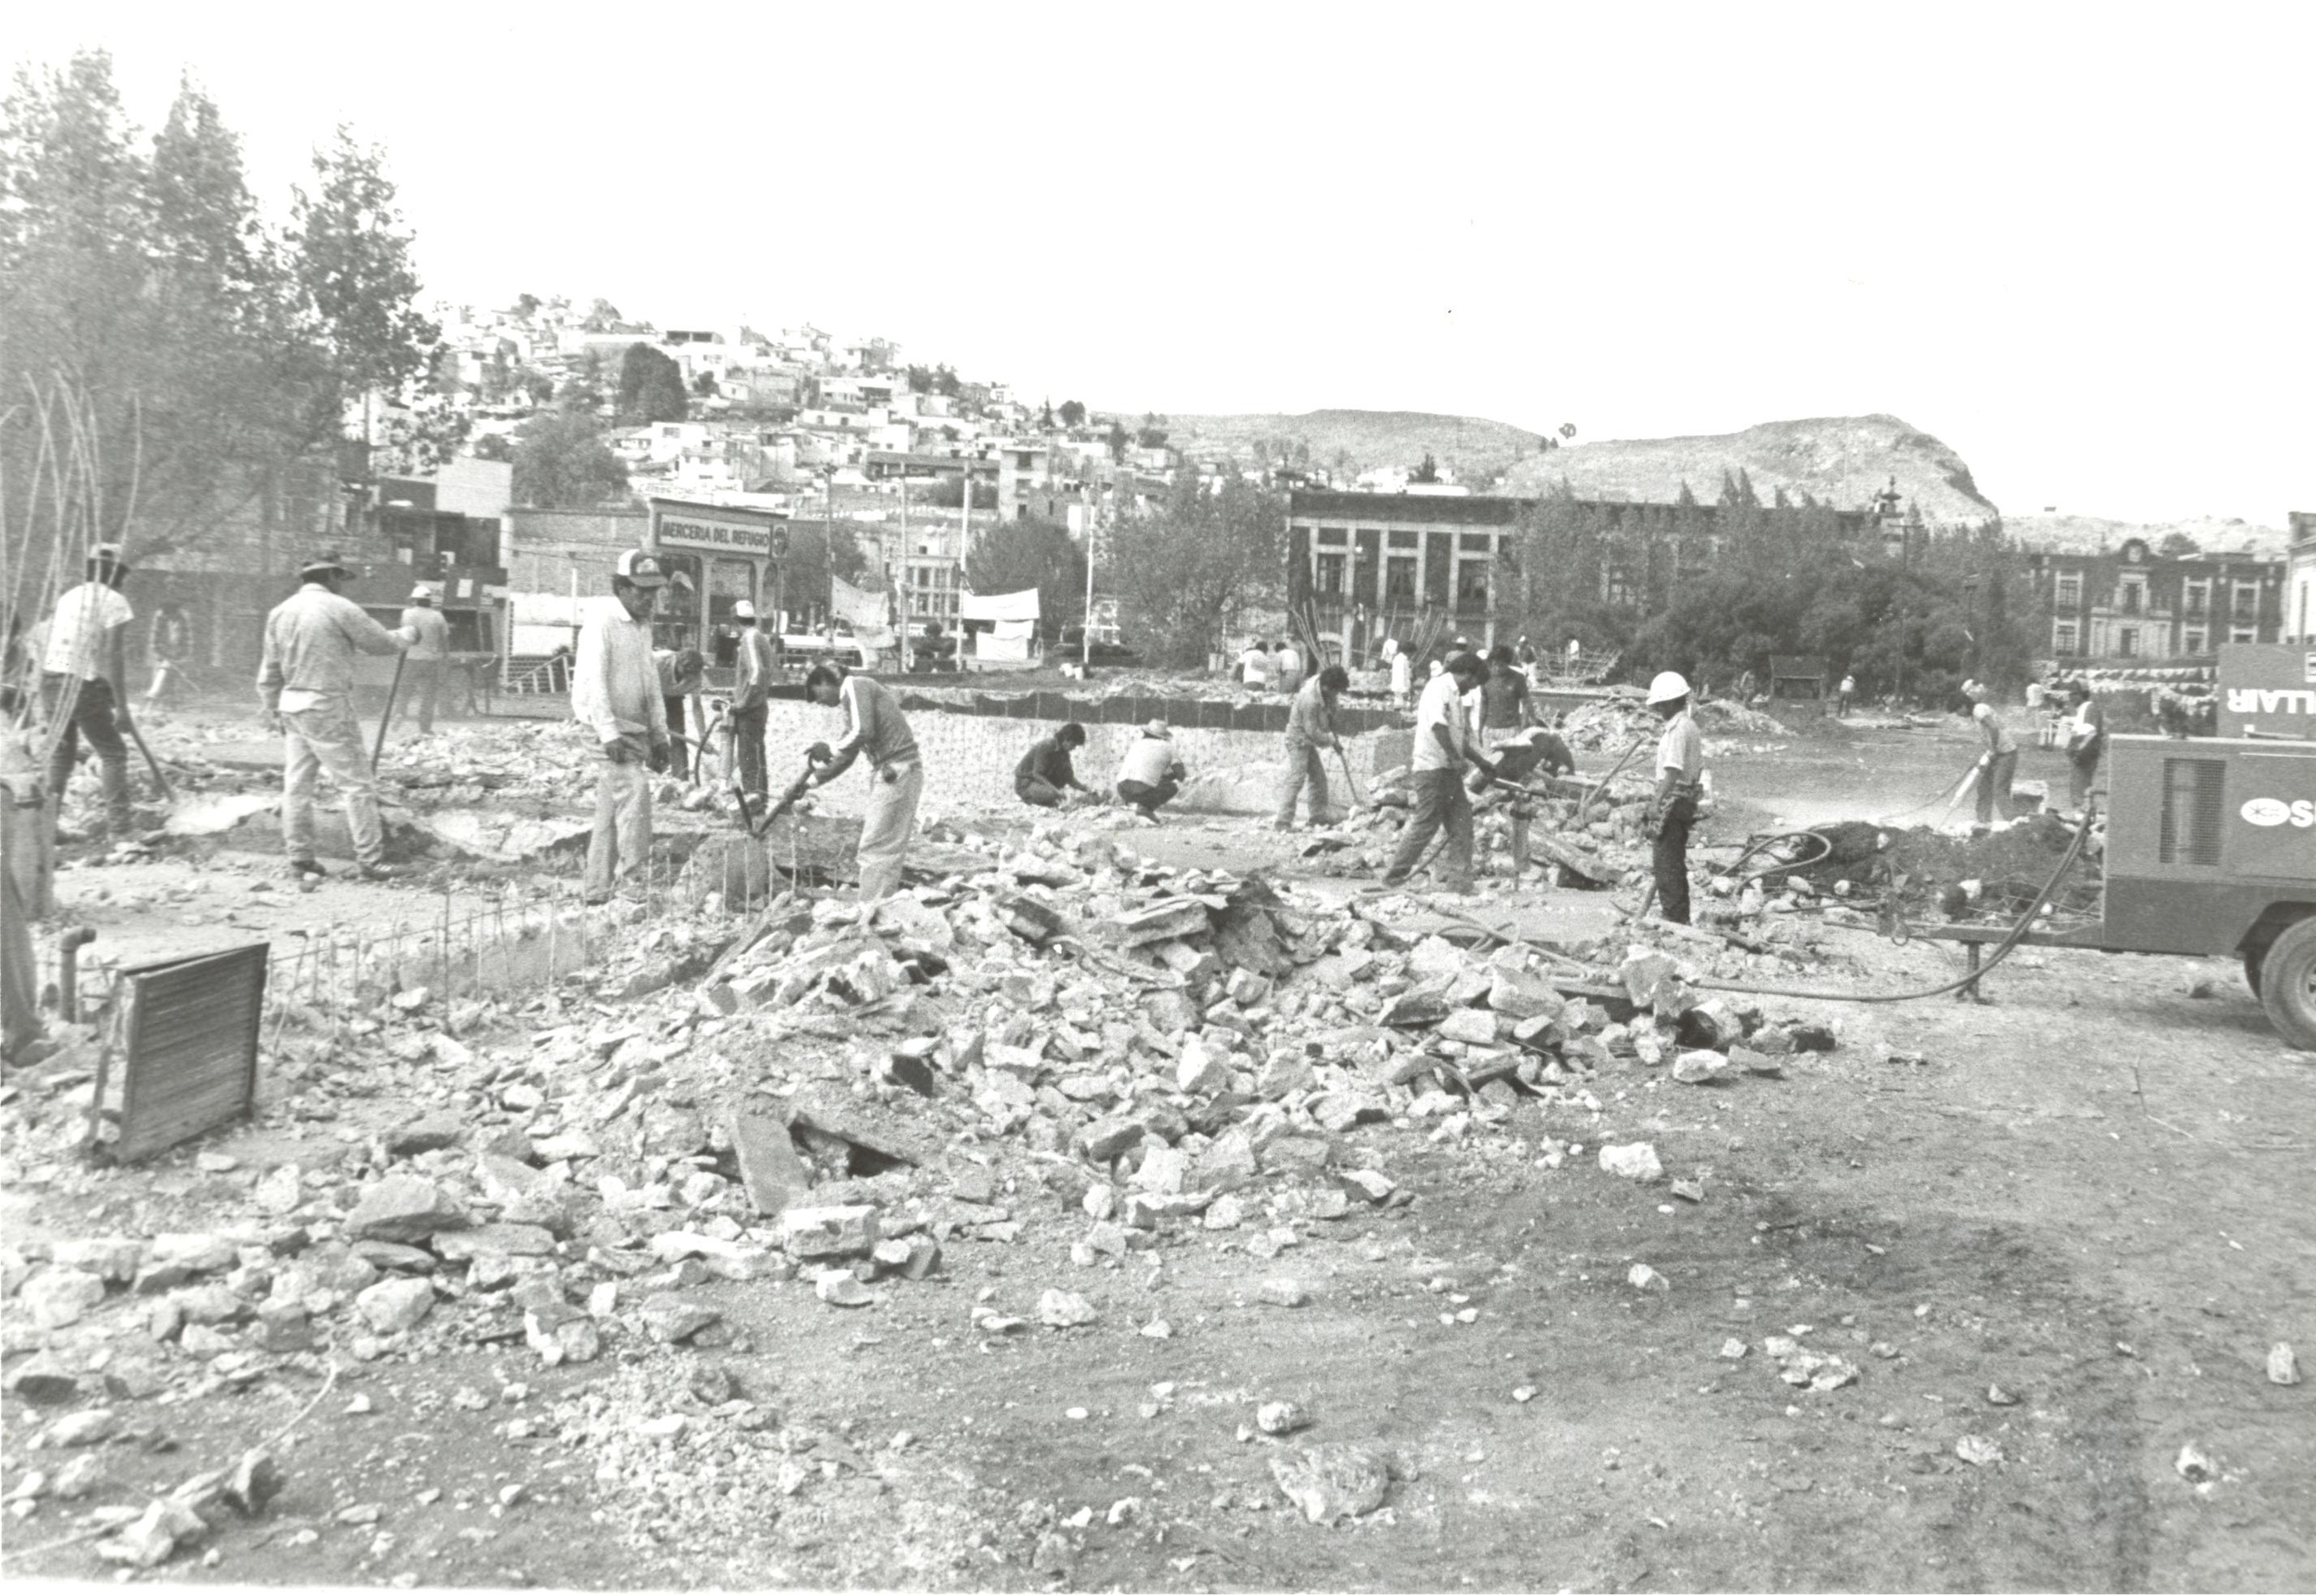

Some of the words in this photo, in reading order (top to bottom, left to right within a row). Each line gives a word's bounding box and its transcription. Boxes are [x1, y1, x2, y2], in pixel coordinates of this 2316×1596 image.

[662, 521, 711, 542] MERCERIA
[713, 527, 730, 543] DEL
[732, 530, 768, 547] REFUGIO
[2227, 689, 2316, 714] LLAIR
[2290, 800, 2316, 828] S
